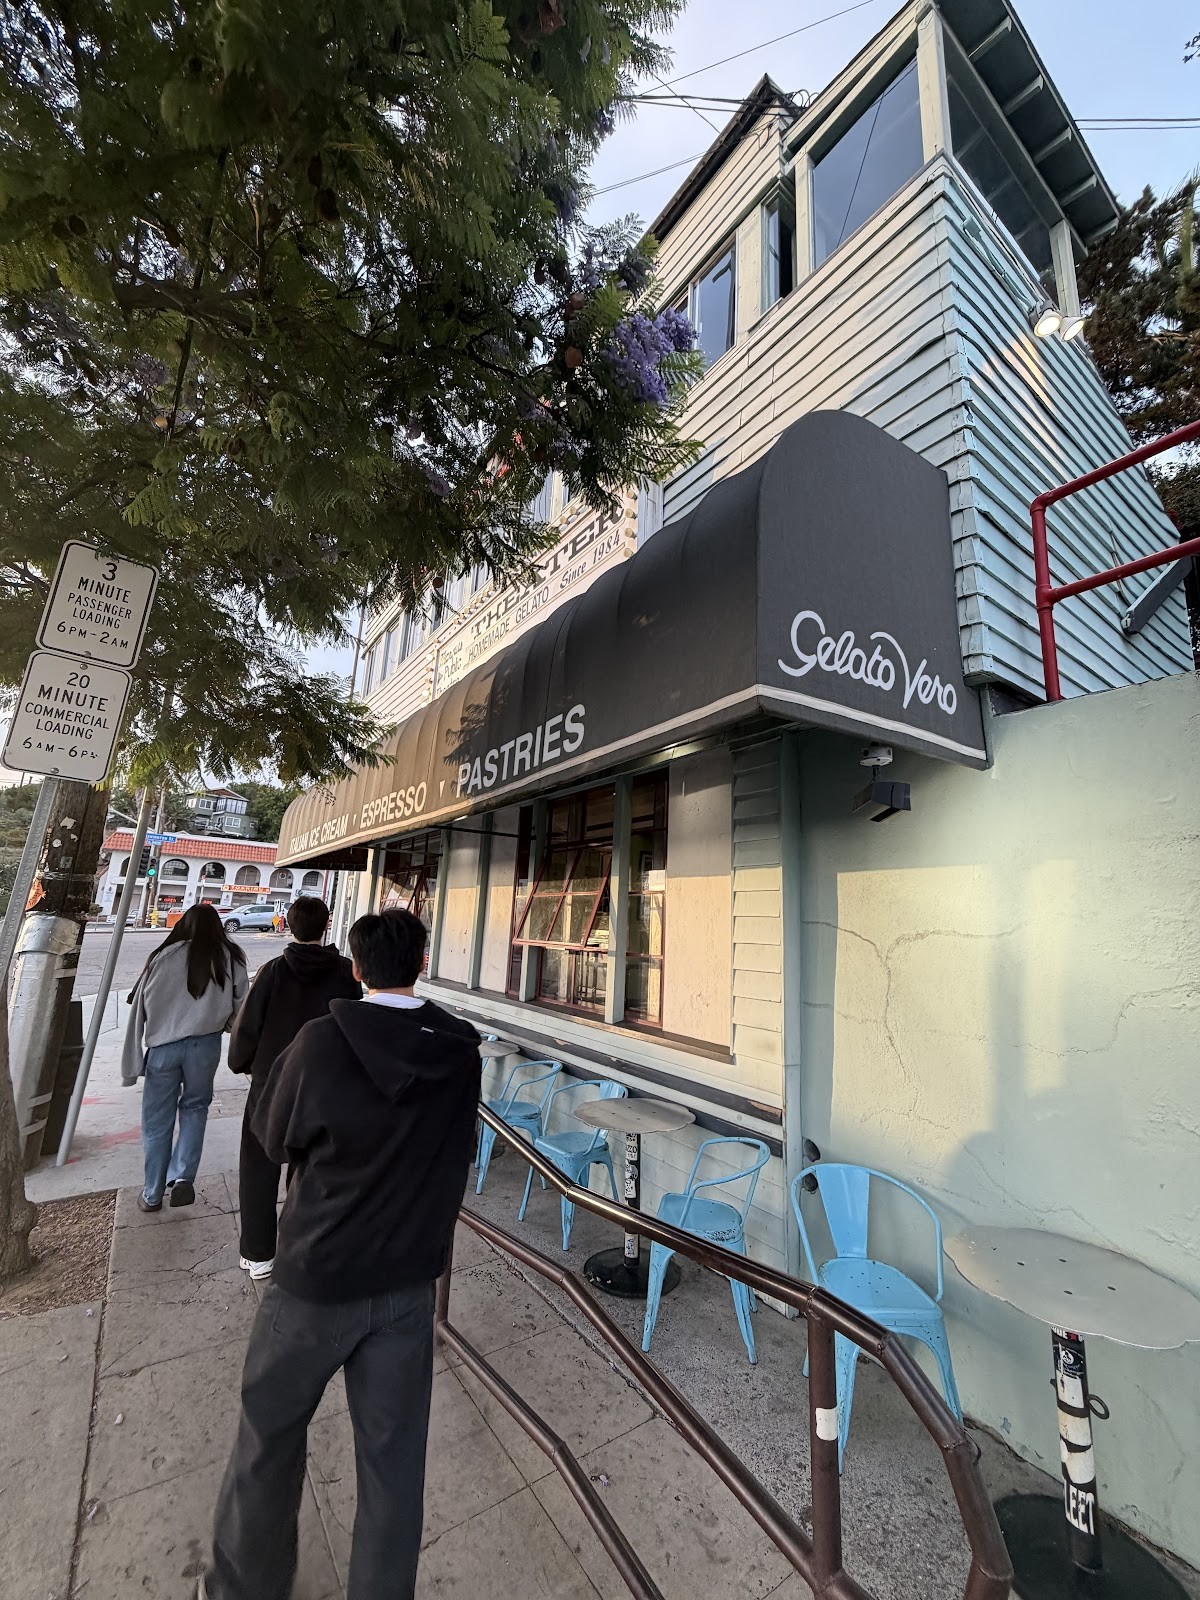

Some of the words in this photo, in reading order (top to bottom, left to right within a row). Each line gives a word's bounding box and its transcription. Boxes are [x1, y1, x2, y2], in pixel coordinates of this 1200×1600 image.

[102, 562, 118, 581] 3
[77, 576, 131, 604] MINUTE
[468, 616, 510, 663] HOMEMADE
[515, 585, 549, 624] GELATO
[560, 561, 587, 589] Since
[593, 528, 620, 565] 1984
[67, 592, 132, 620] PASSENGER
[72, 607, 121, 629] LOADING
[777, 610, 896, 691] Gelato
[870, 631, 957, 715] Vero
[66, 672, 91, 689] 20
[37, 684, 109, 713] MINUTE
[24, 702, 110, 729] COMMERCIAL
[35, 718, 94, 740] LOADING
[308, 825, 321, 848] ICE
[320, 813, 350, 844] CREAM
[359, 781, 427, 829] ESPRESSO
[456, 703, 586, 799] PASTRIES
